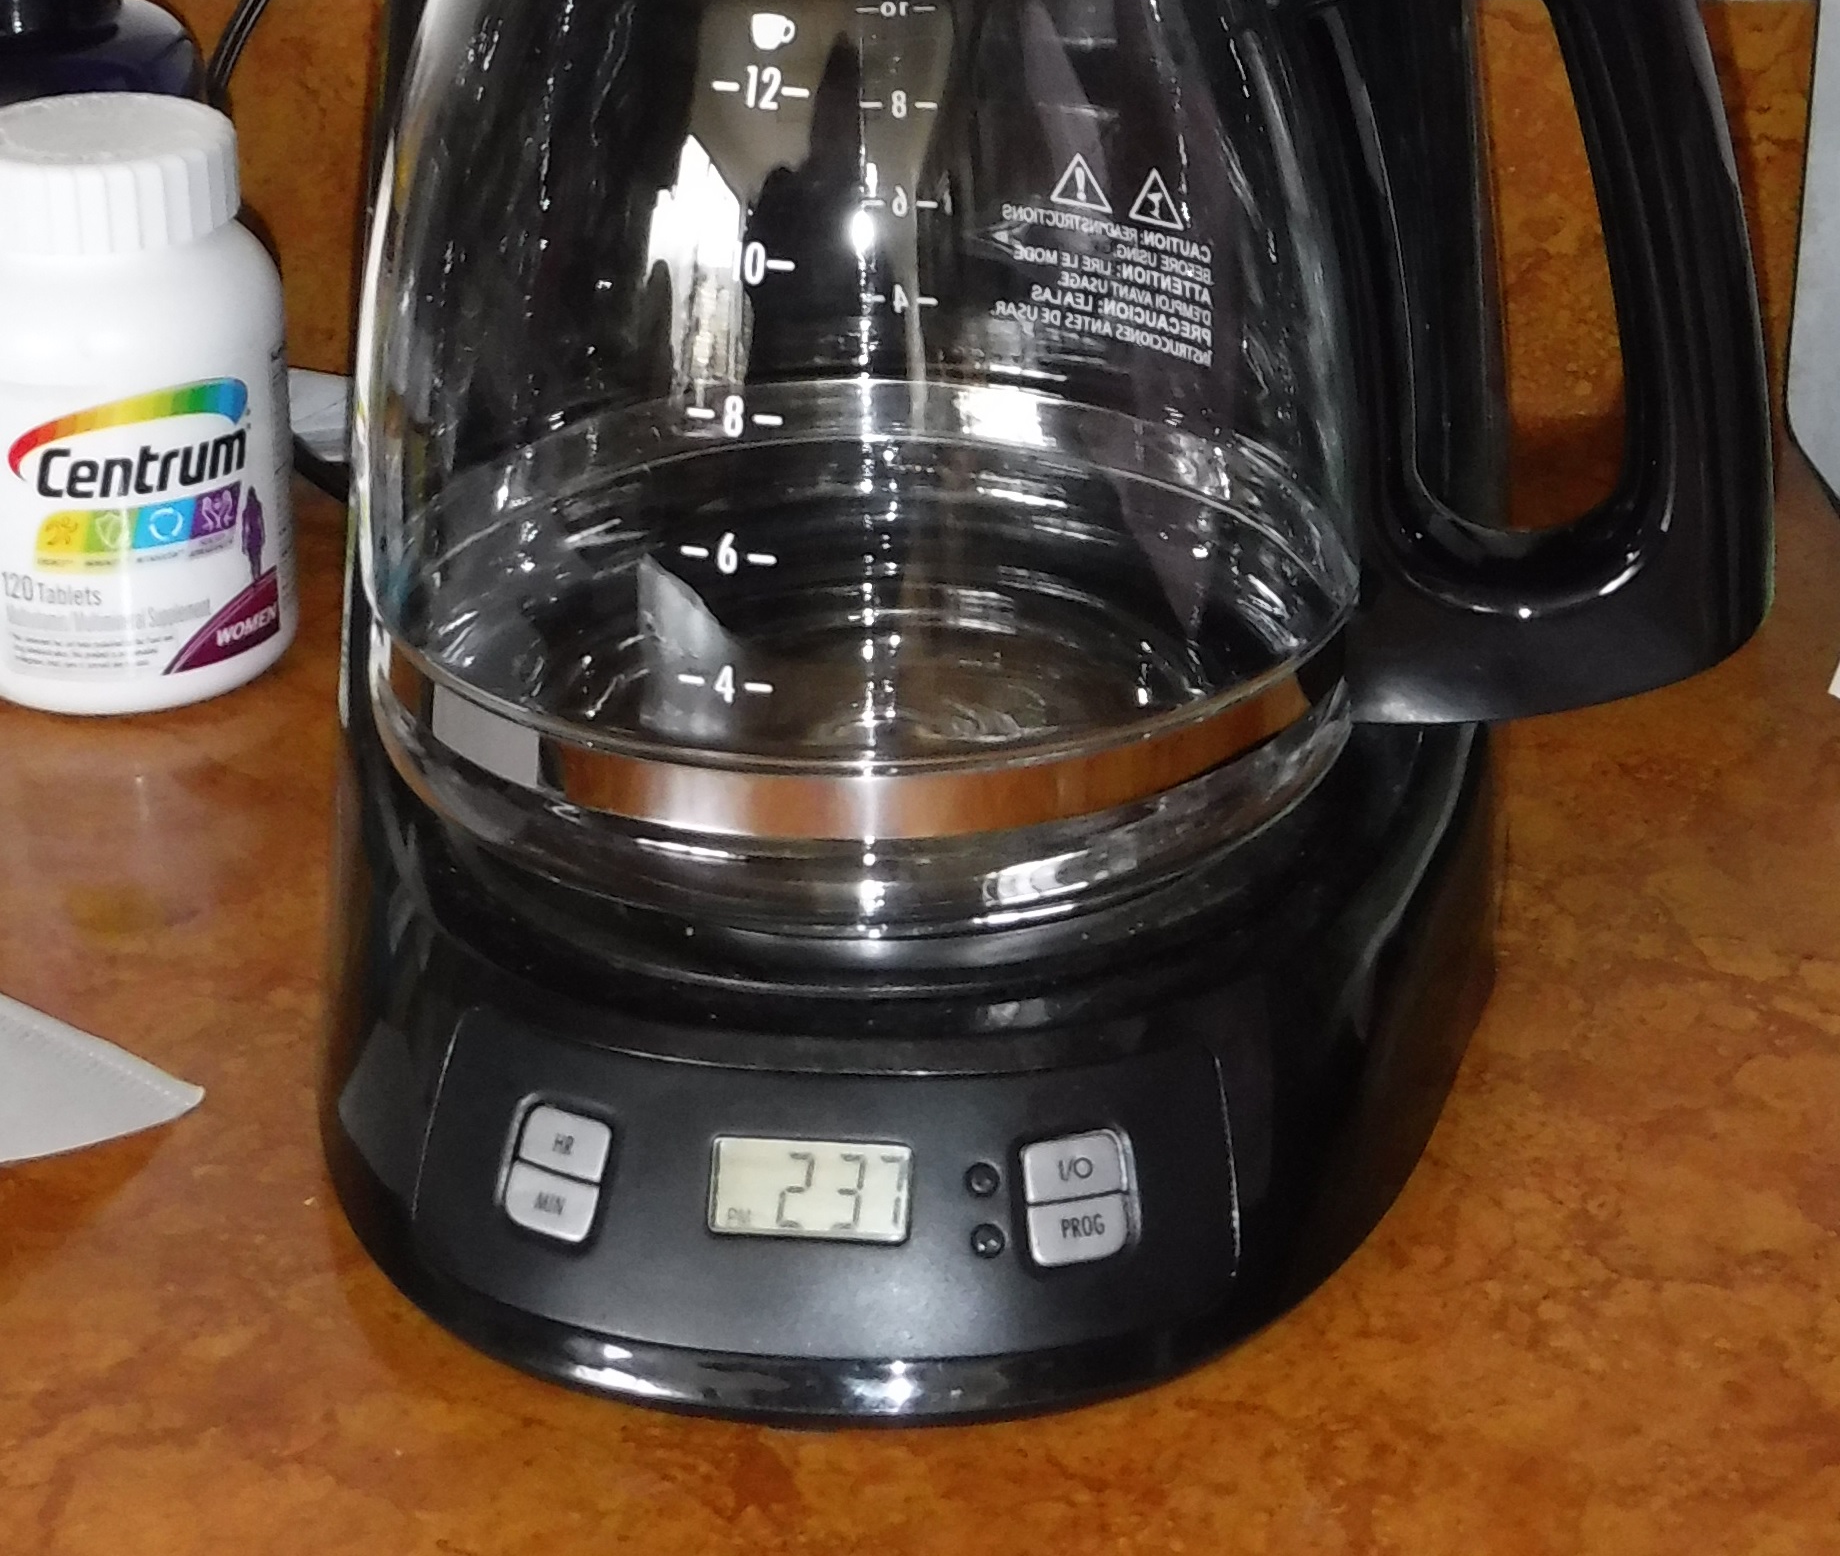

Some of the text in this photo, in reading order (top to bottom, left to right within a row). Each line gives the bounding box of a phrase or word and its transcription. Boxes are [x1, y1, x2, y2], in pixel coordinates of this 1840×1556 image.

[723, 395, 745, 437] 8
[37, 429, 247, 499] Centrum
[717, 532, 739, 575] 6
[2, 571, 102, 606] 120 Tablets
[216, 604, 277, 647] WOMEN
[714, 664, 736, 704] 4
[552, 1133, 574, 1155] HR
[533, 1192, 566, 1215] MIN
[1061, 1213, 1105, 1239] PROG
